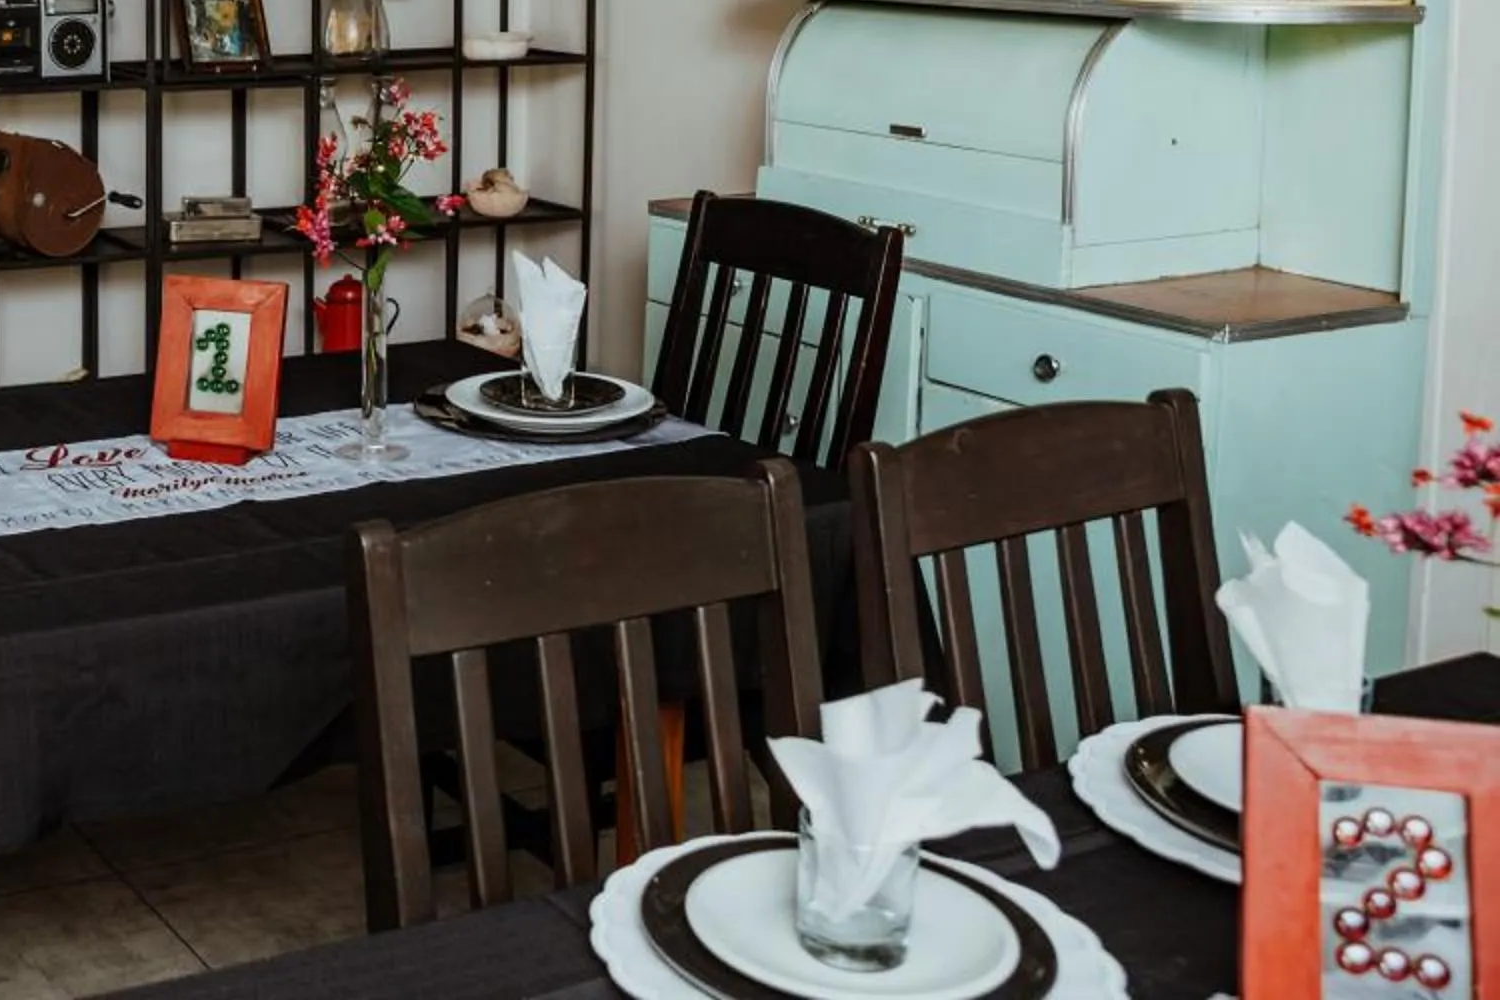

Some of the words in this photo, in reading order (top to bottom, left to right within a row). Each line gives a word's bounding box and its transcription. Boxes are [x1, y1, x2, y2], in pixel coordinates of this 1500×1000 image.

[19, 443, 146, 471] Love
[47, 462, 138, 493] EVERY
[1332, 807, 1453, 989] 2
